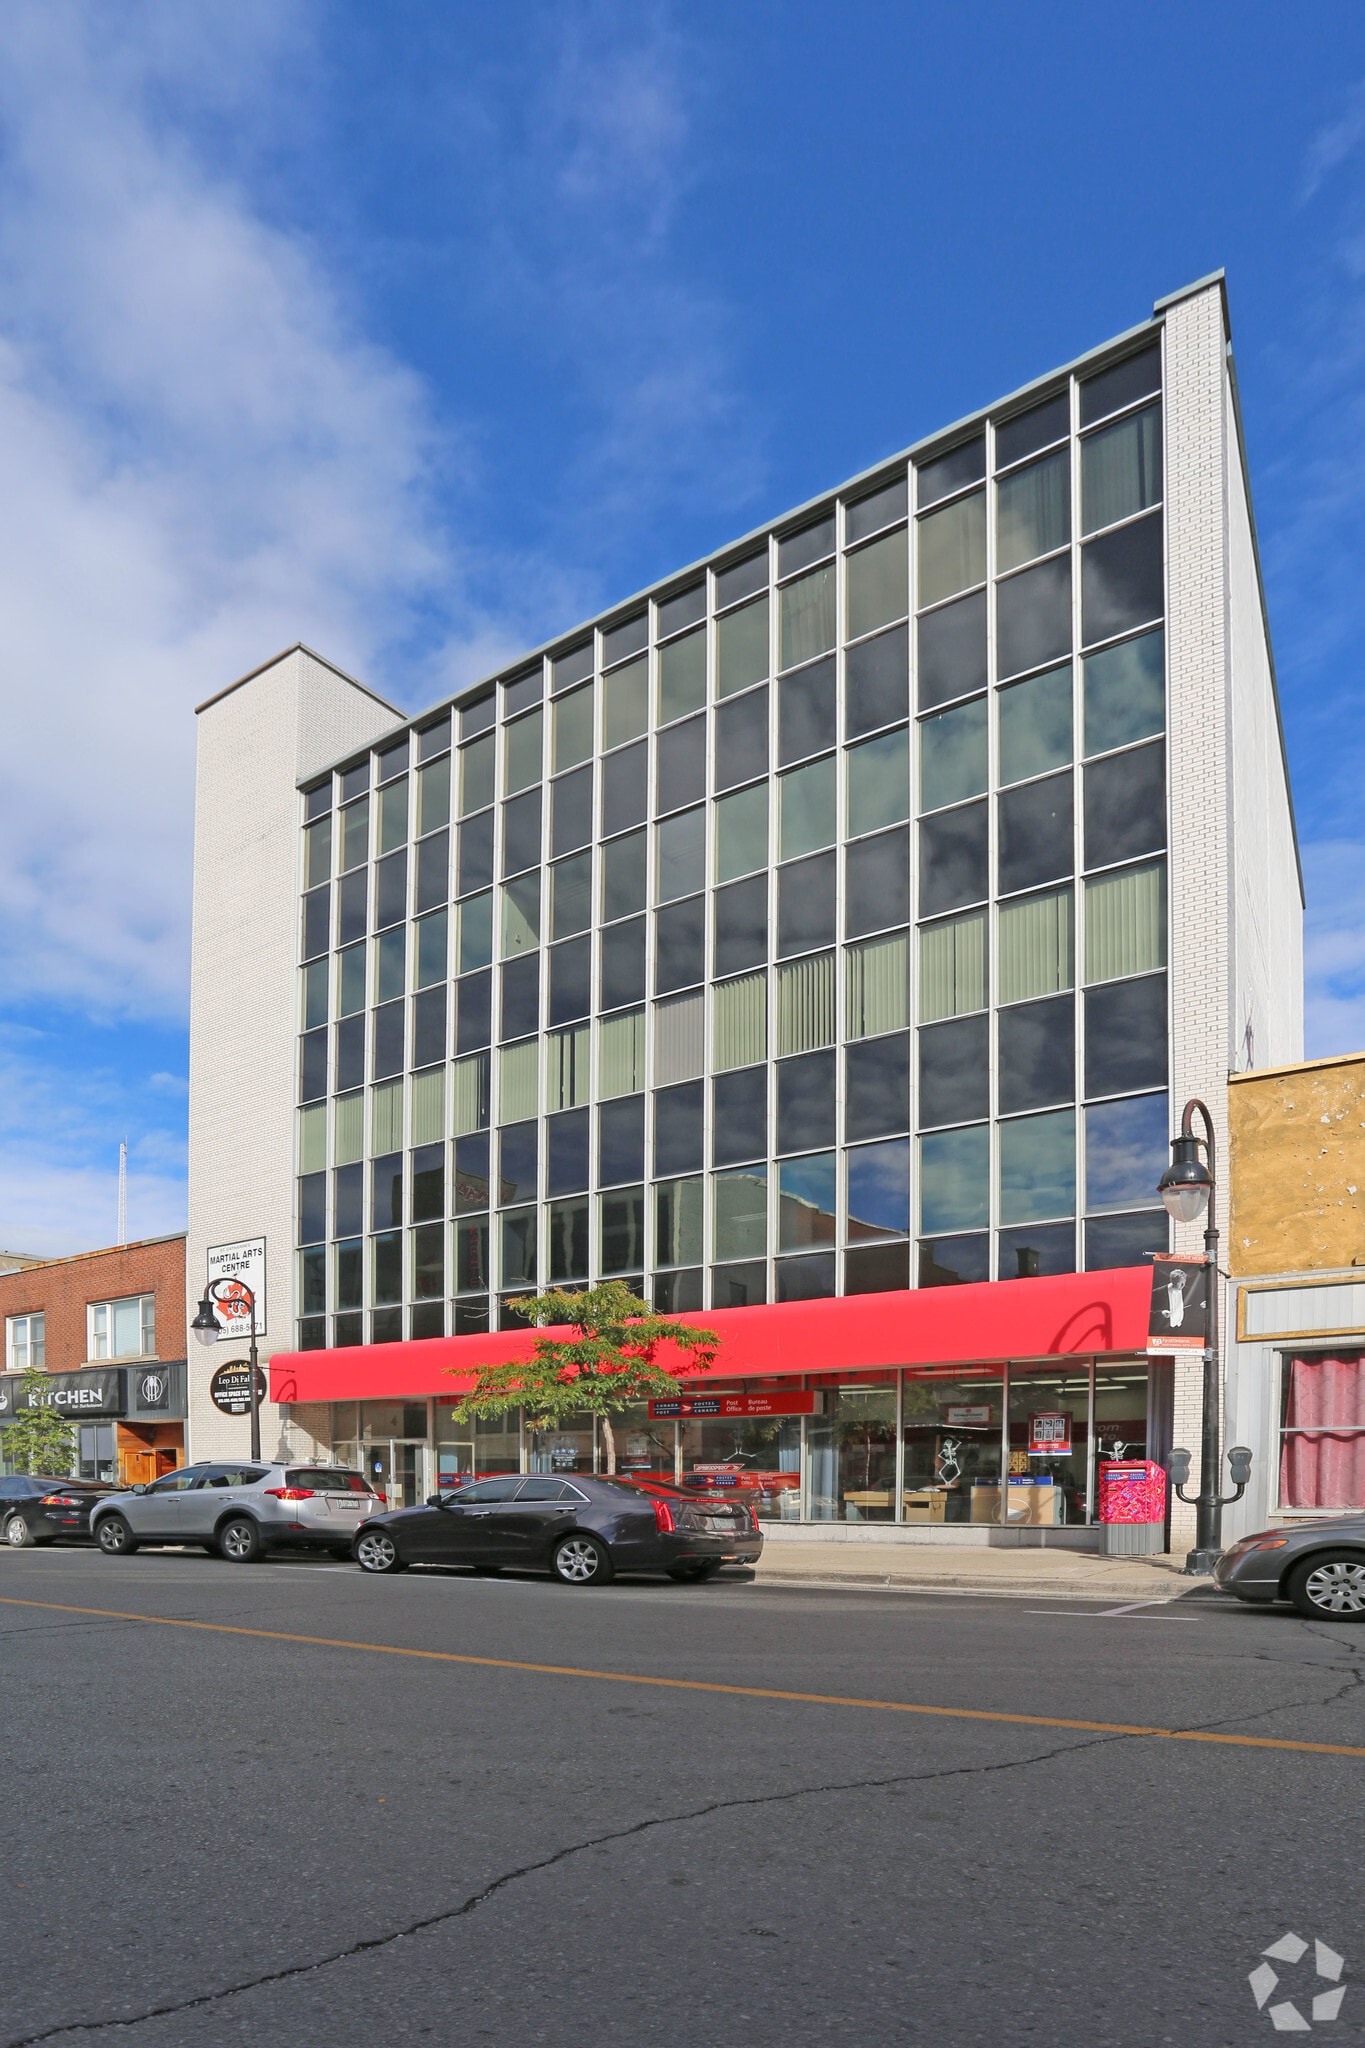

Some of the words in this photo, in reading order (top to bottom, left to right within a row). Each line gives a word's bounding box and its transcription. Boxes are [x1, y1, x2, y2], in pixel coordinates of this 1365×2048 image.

[210, 1252, 240, 1265] MARTIAL
[242, 1247, 263, 1259] ARTS
[221, 1260, 250, 1273] CENTRE
[231, 1322, 263, 1333] 688-571
[218, 1376, 230, 1384] Leo
[756, 1404, 772, 1412] poste
